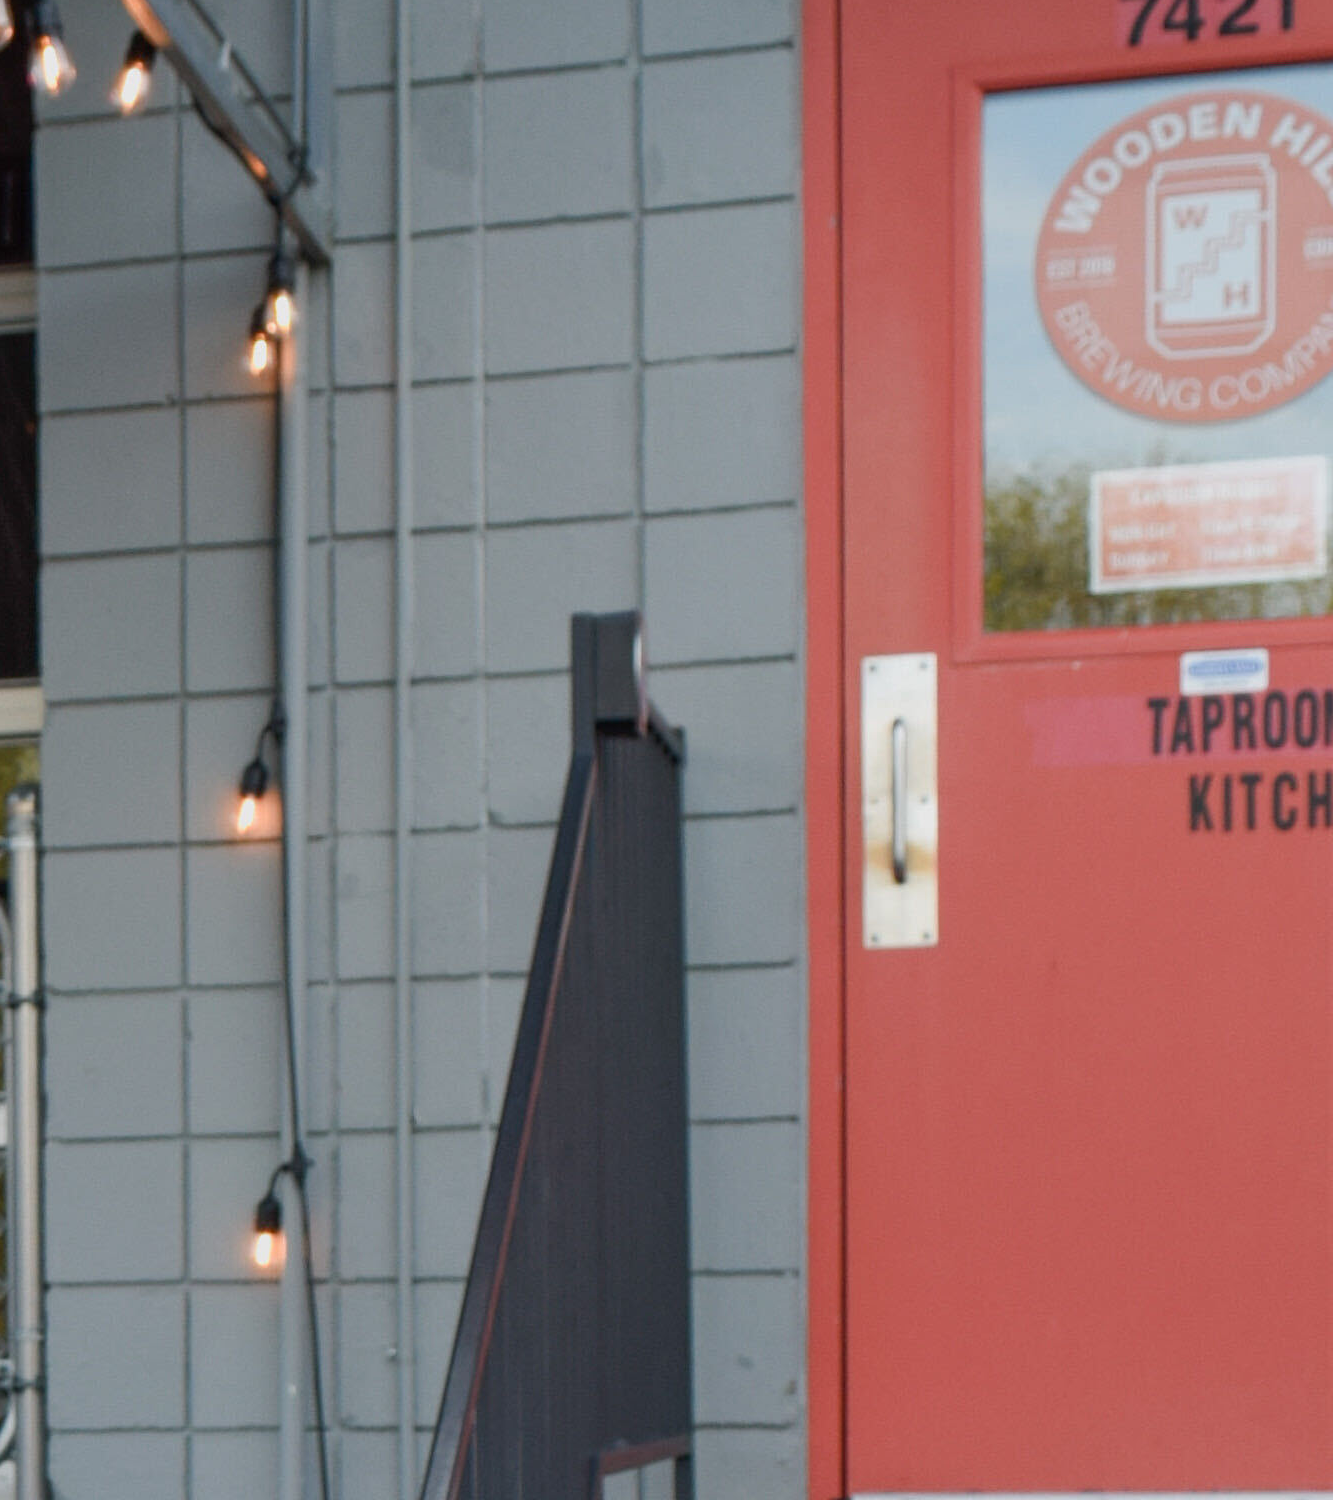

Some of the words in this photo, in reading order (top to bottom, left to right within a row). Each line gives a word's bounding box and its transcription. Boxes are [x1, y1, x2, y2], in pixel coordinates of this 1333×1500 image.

[1051, 100, 1264, 234] WOODEN
[1268, 111, 1333, 208] HIL
[1172, 202, 1209, 231] W
[1222, 279, 1251, 309] H
[1053, 299, 1203, 412] BREWING
[1208, 306, 1333, 410] COMPA
[1189, 769, 1333, 832] KITCH
